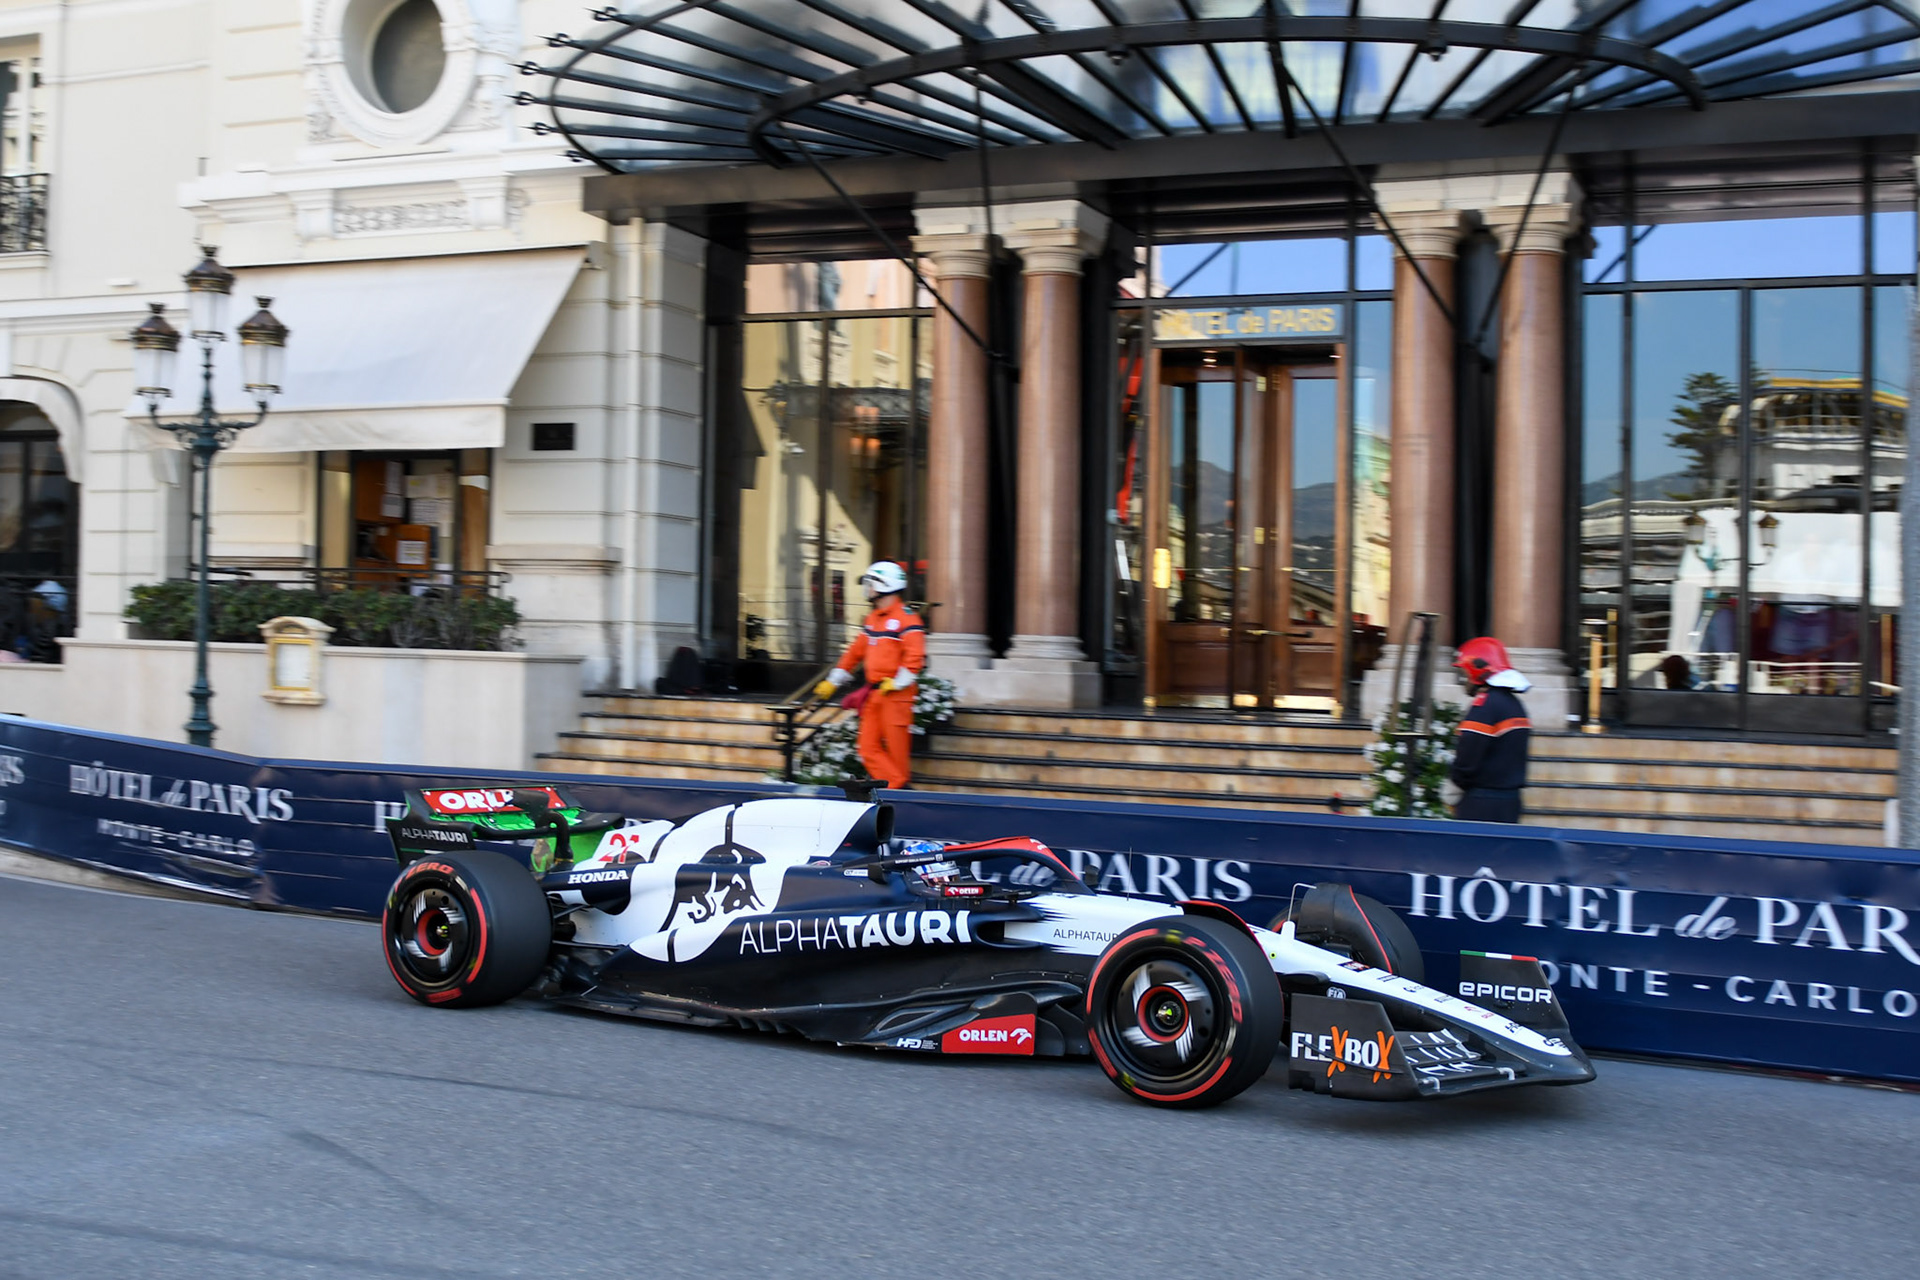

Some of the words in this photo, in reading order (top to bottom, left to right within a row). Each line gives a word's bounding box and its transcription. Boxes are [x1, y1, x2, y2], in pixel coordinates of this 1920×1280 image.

[1237, 310, 1265, 334] de
[1268, 307, 1336, 333] PARIS
[70, 761, 153, 802] HÔTEL
[161, 779, 188, 806] de
[190, 781, 294, 824] PARIS
[402, 827, 469, 844] ALPHATAURI
[568, 869, 628, 885] HONDA
[958, 887, 979, 895] ORLEN
[1068, 849, 1253, 902] PARIS
[739, 910, 973, 955] ALPHATAURI
[1407, 866, 1661, 937] HÔTEL
[1674, 896, 1740, 941] de
[1753, 896, 1920, 967] PAR
[959, 1029, 1008, 1042] ORLEN
[1291, 1026, 1395, 1083] FLEXBOX
